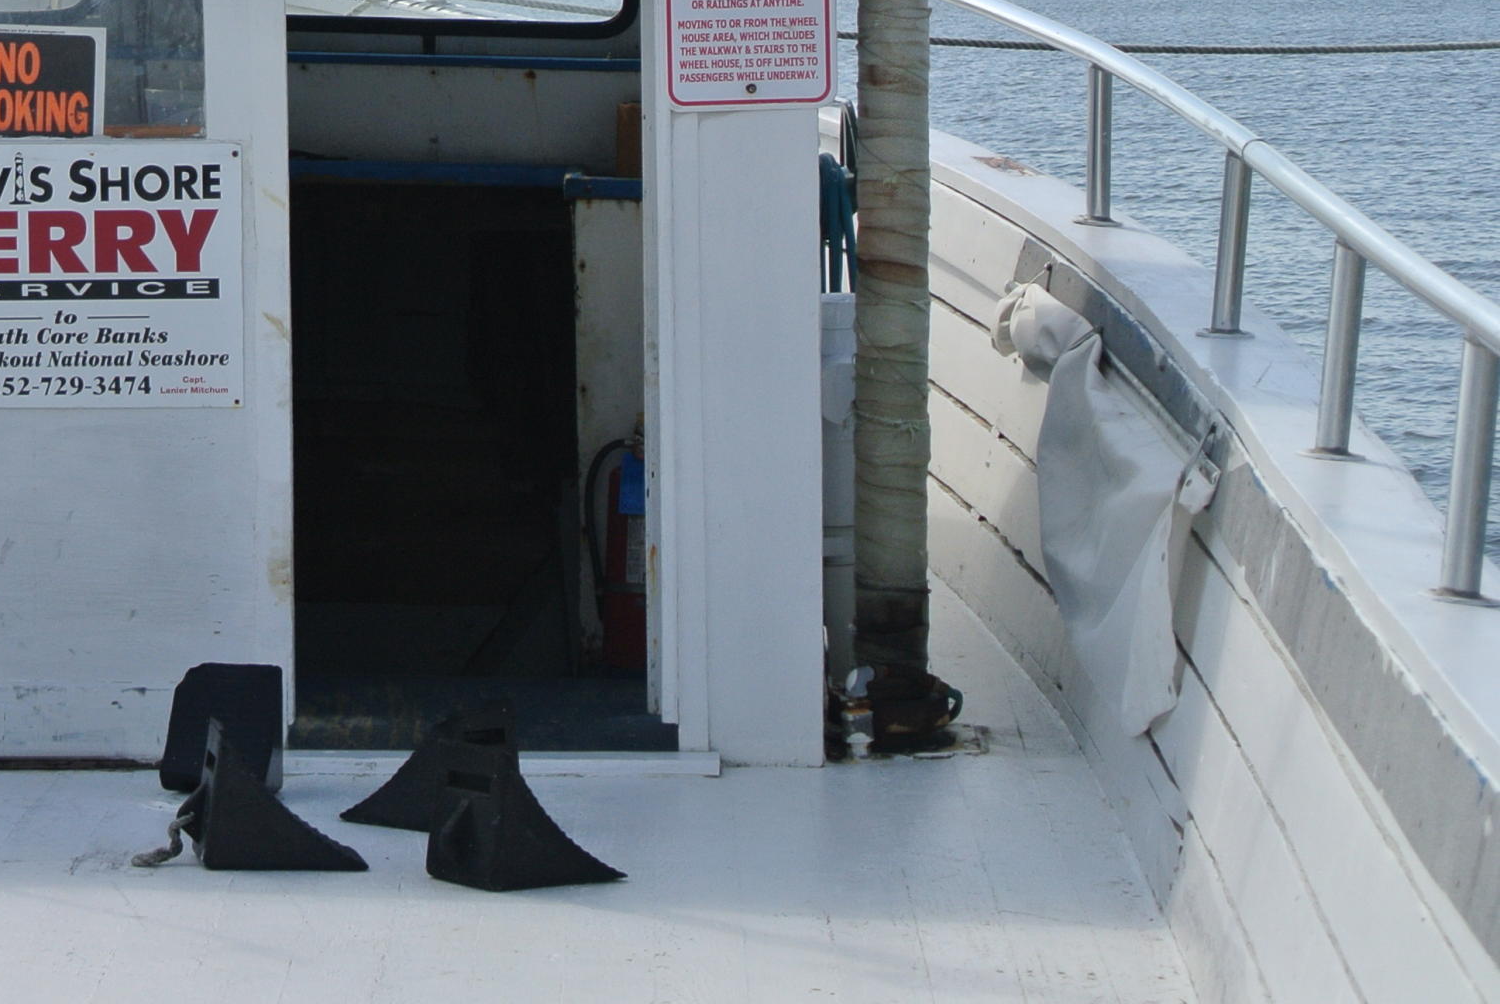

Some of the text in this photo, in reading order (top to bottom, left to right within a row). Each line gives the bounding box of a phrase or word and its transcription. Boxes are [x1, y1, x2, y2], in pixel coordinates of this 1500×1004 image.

[691, 0, 704, 9] OR
[706, 0, 748, 9] RAILINGS
[750, 0, 761, 8] AT
[678, 17, 819, 29] MOVING TO OR FROM THE WHEEL
[681, 30, 815, 43] HOUSE AREA, WHICH INCLUDES
[680, 44, 817, 56] THE WALKWAY & STAIRS TO THE
[679, 57, 818, 69] WHEEL HOUSE, IS OFF LIMITS TO
[679, 70, 819, 83] PASSENGERS WHILE UNDERWAY.
[69, 159, 222, 203] SHORE
[54, 310, 78, 324] to
[37, 328, 88, 344] Core
[95, 326, 168, 344] Banks
[48, 350, 133, 367] National
[138, 349, 230, 367] Seashore
[182, 376, 206, 385] Capt.
[190, 386, 229, 394] Mitchum
